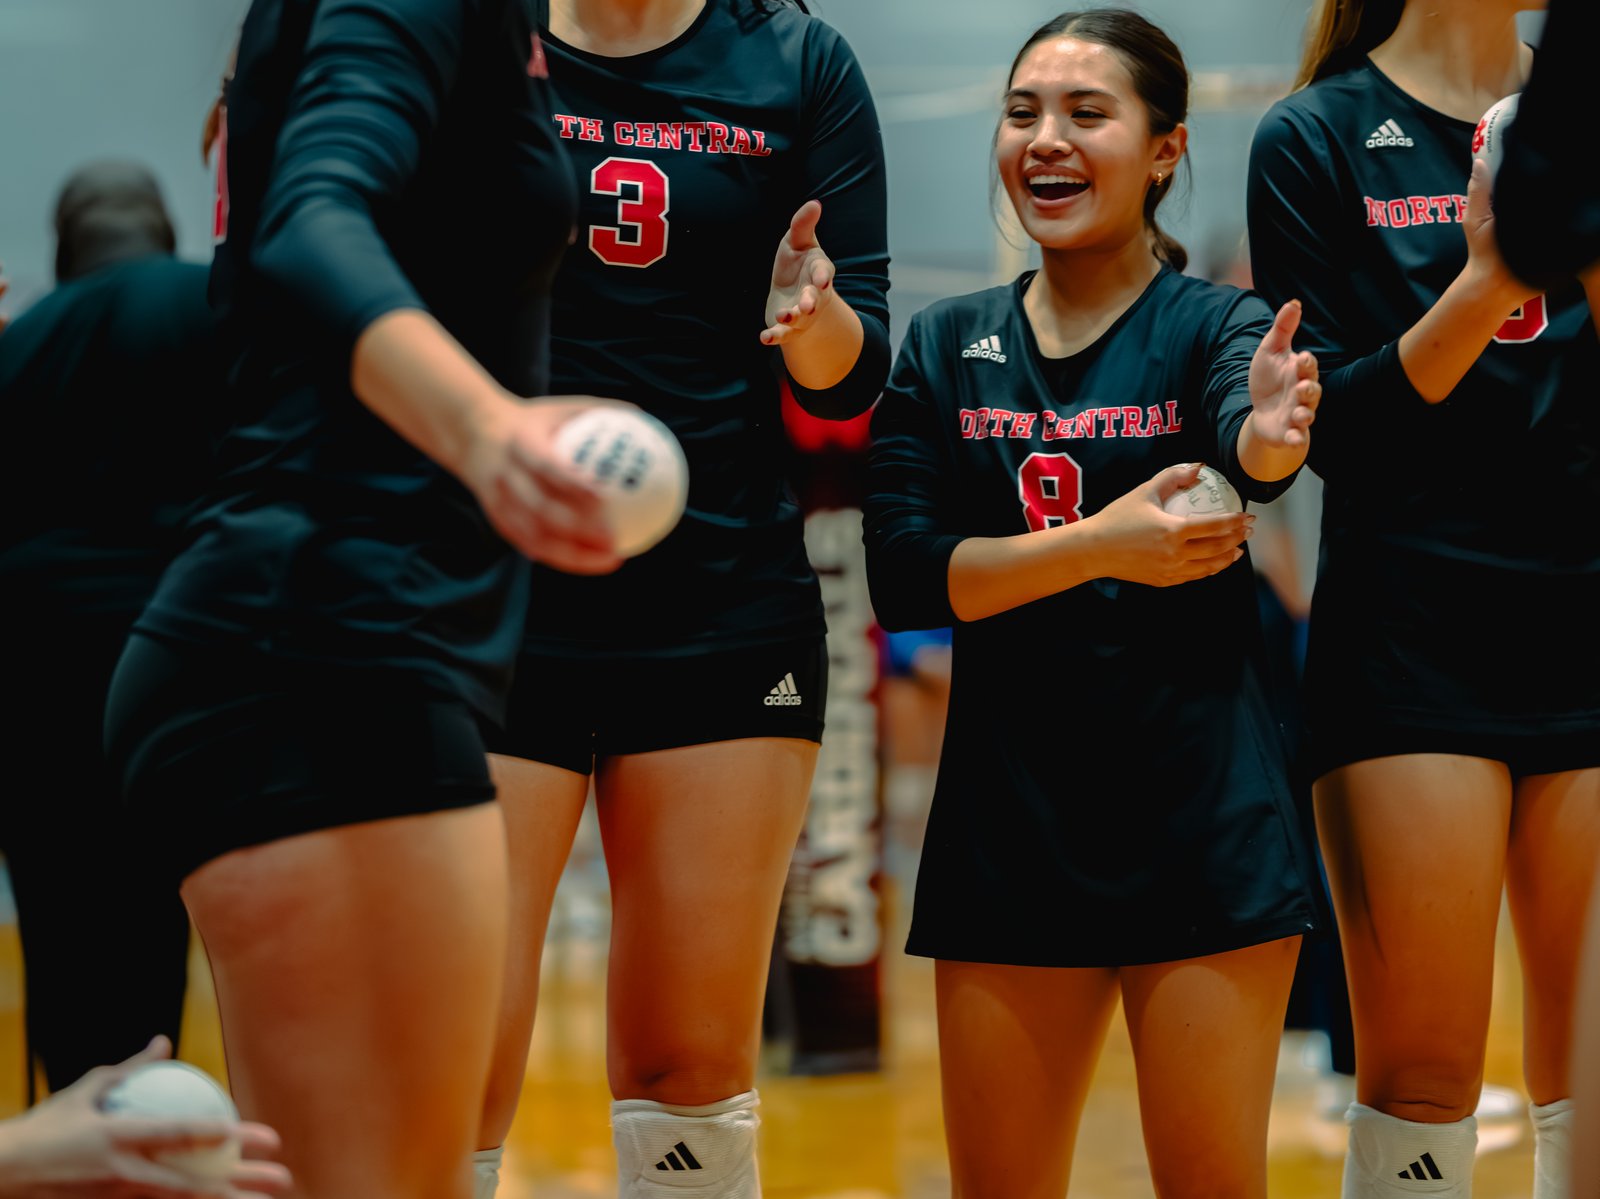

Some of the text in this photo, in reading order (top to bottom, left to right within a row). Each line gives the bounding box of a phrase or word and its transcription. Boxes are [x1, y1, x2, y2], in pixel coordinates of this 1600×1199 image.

[613, 121, 772, 156] CENTRAL
[1365, 134, 1414, 149] adidas
[588, 156, 670, 268] 3
[961, 346, 1007, 364] adidas
[959, 400, 1183, 442] ORTH CENTRAL
[1017, 452, 1083, 532] 8
[763, 693, 802, 706] adidas
